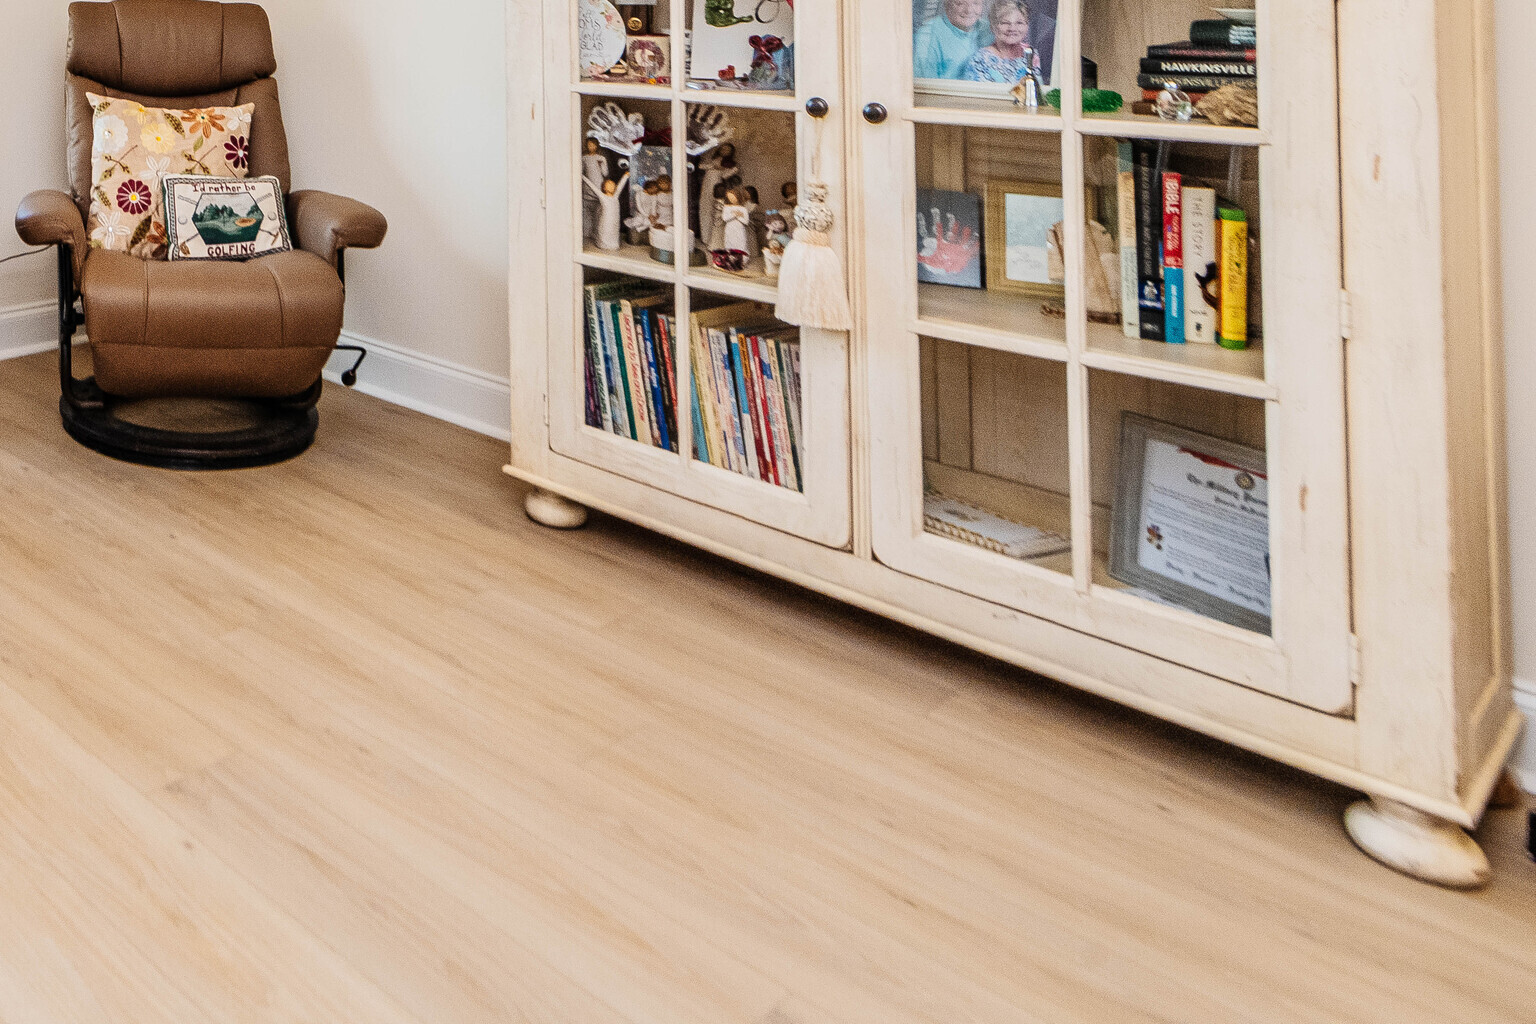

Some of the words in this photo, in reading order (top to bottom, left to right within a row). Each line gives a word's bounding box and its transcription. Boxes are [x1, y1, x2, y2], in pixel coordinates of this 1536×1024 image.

[1161, 62, 1256, 75] HAWKINSVILLE
[192, 182, 206, 192] I'd
[209, 182, 241, 192] rather
[244, 182, 256, 191] be
[1192, 221, 1204, 257] STORY
[207, 243, 255, 257] GOLFING
